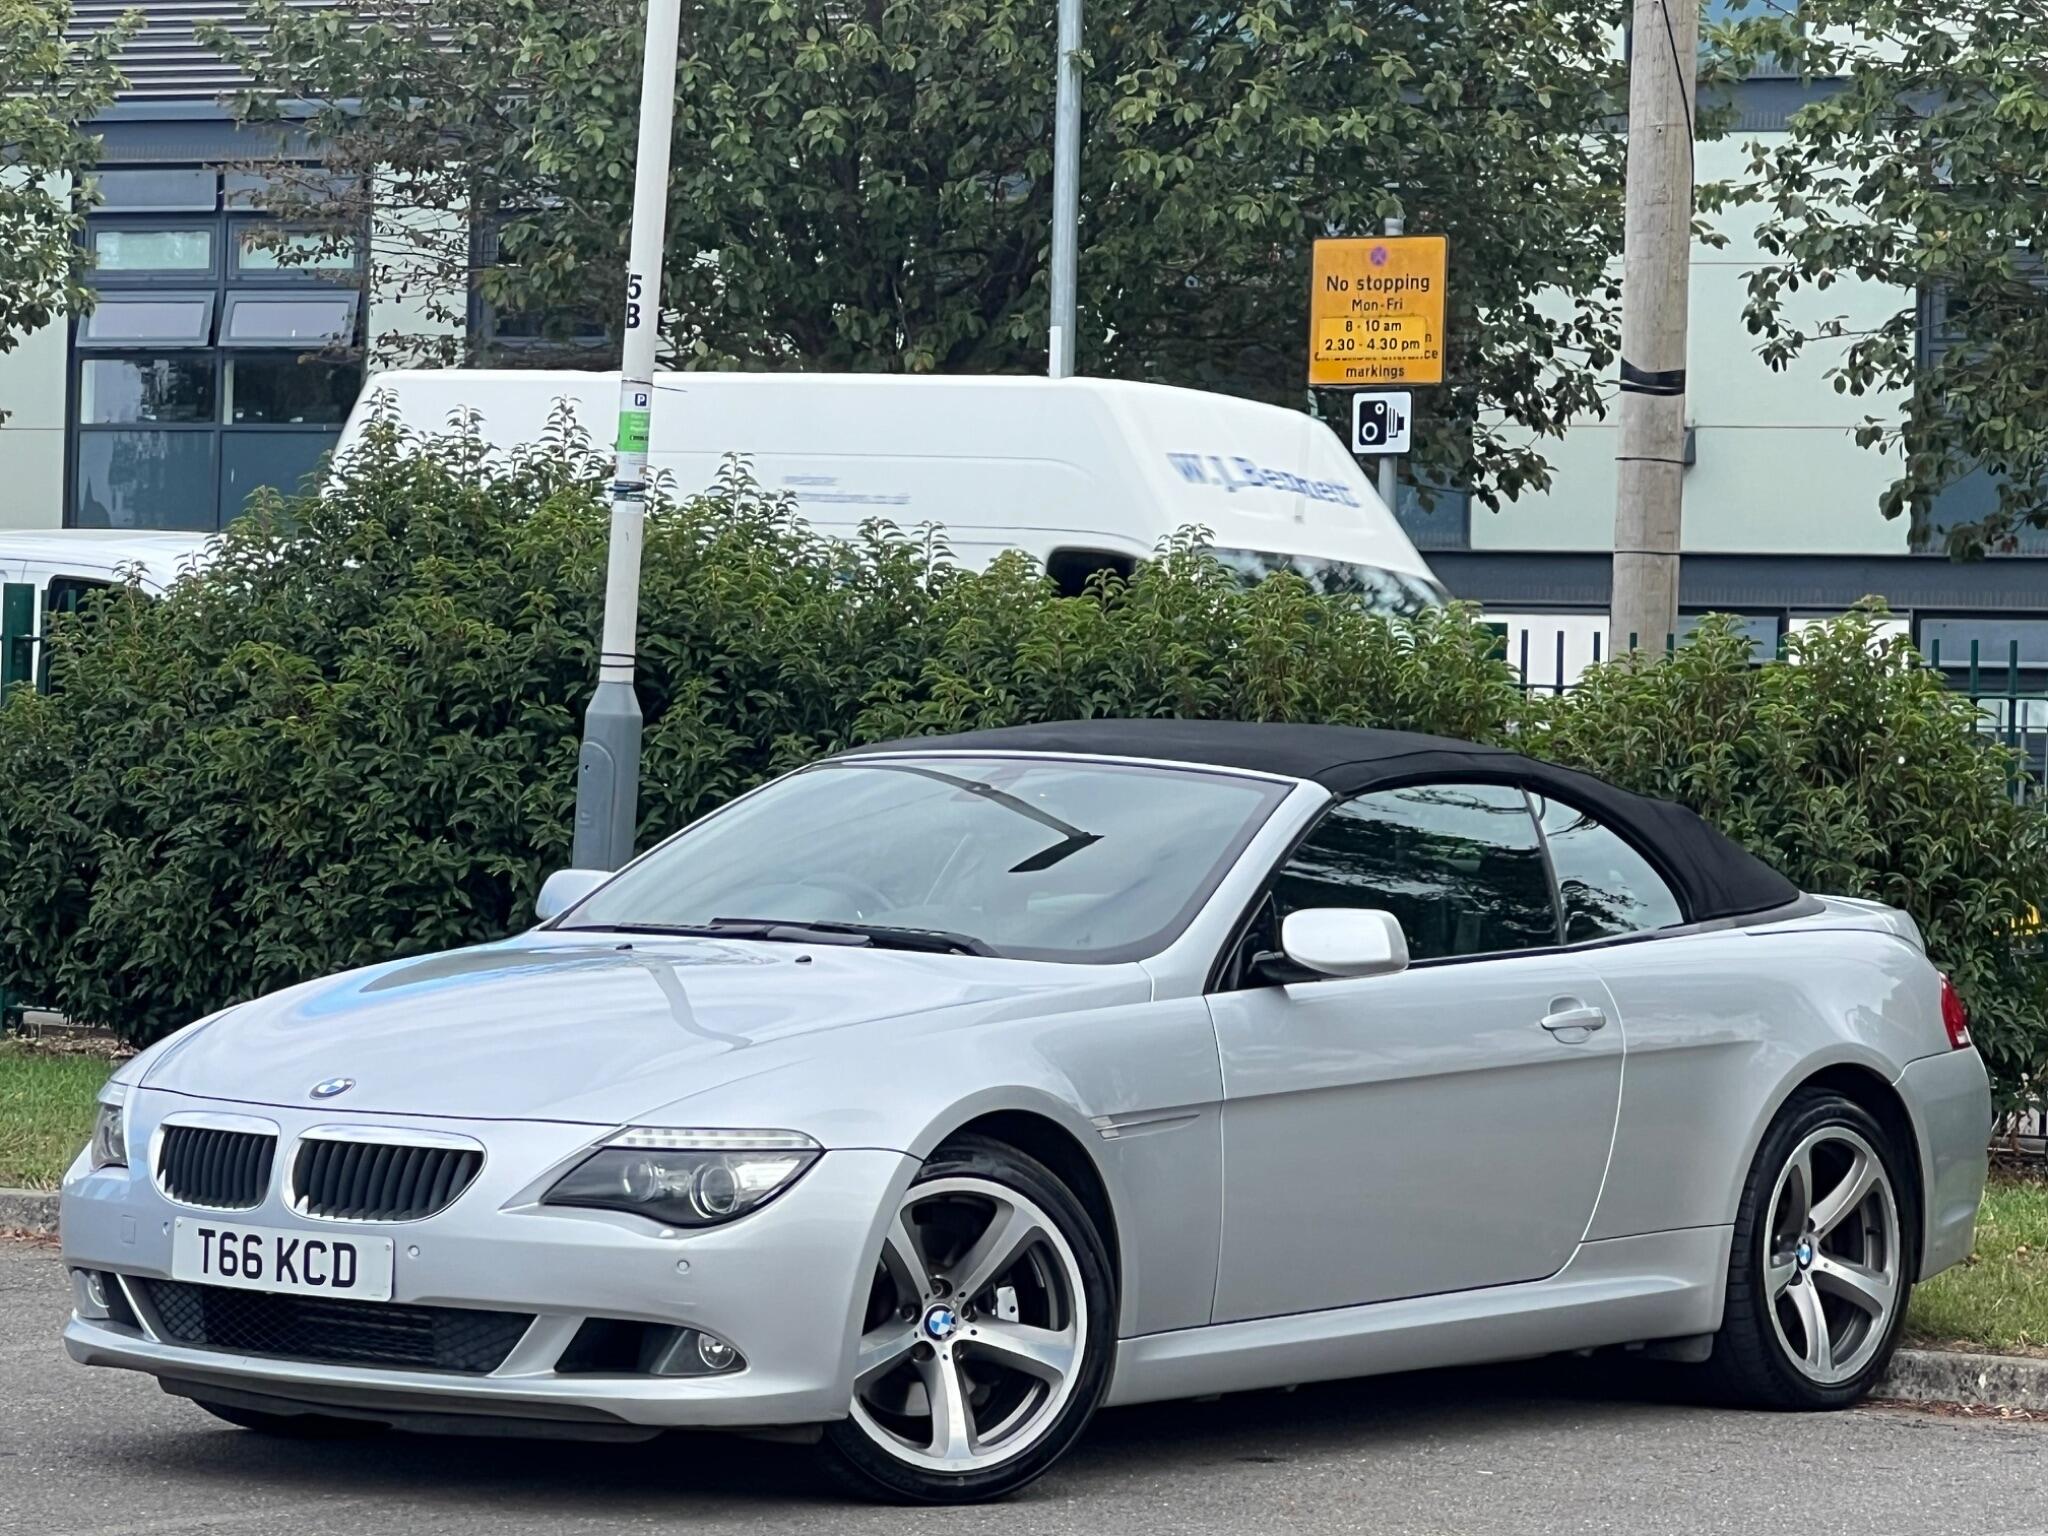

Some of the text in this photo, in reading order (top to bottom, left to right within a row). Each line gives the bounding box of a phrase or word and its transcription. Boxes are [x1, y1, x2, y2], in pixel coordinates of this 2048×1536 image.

[628, 274, 642, 300] 5
[1326, 273, 1430, 293] No stopping
[625, 303, 641, 329] B
[1345, 320, 1353, 332] 8
[1365, 320, 1380, 332] 10
[1383, 321, 1402, 332] am
[1325, 338, 1355, 351] 2.30
[1366, 338, 1398, 350] 4.30
[1401, 339, 1420, 352] pm
[1346, 364, 1405, 379] markings
[198, 1228, 358, 1288] T66 KCD
